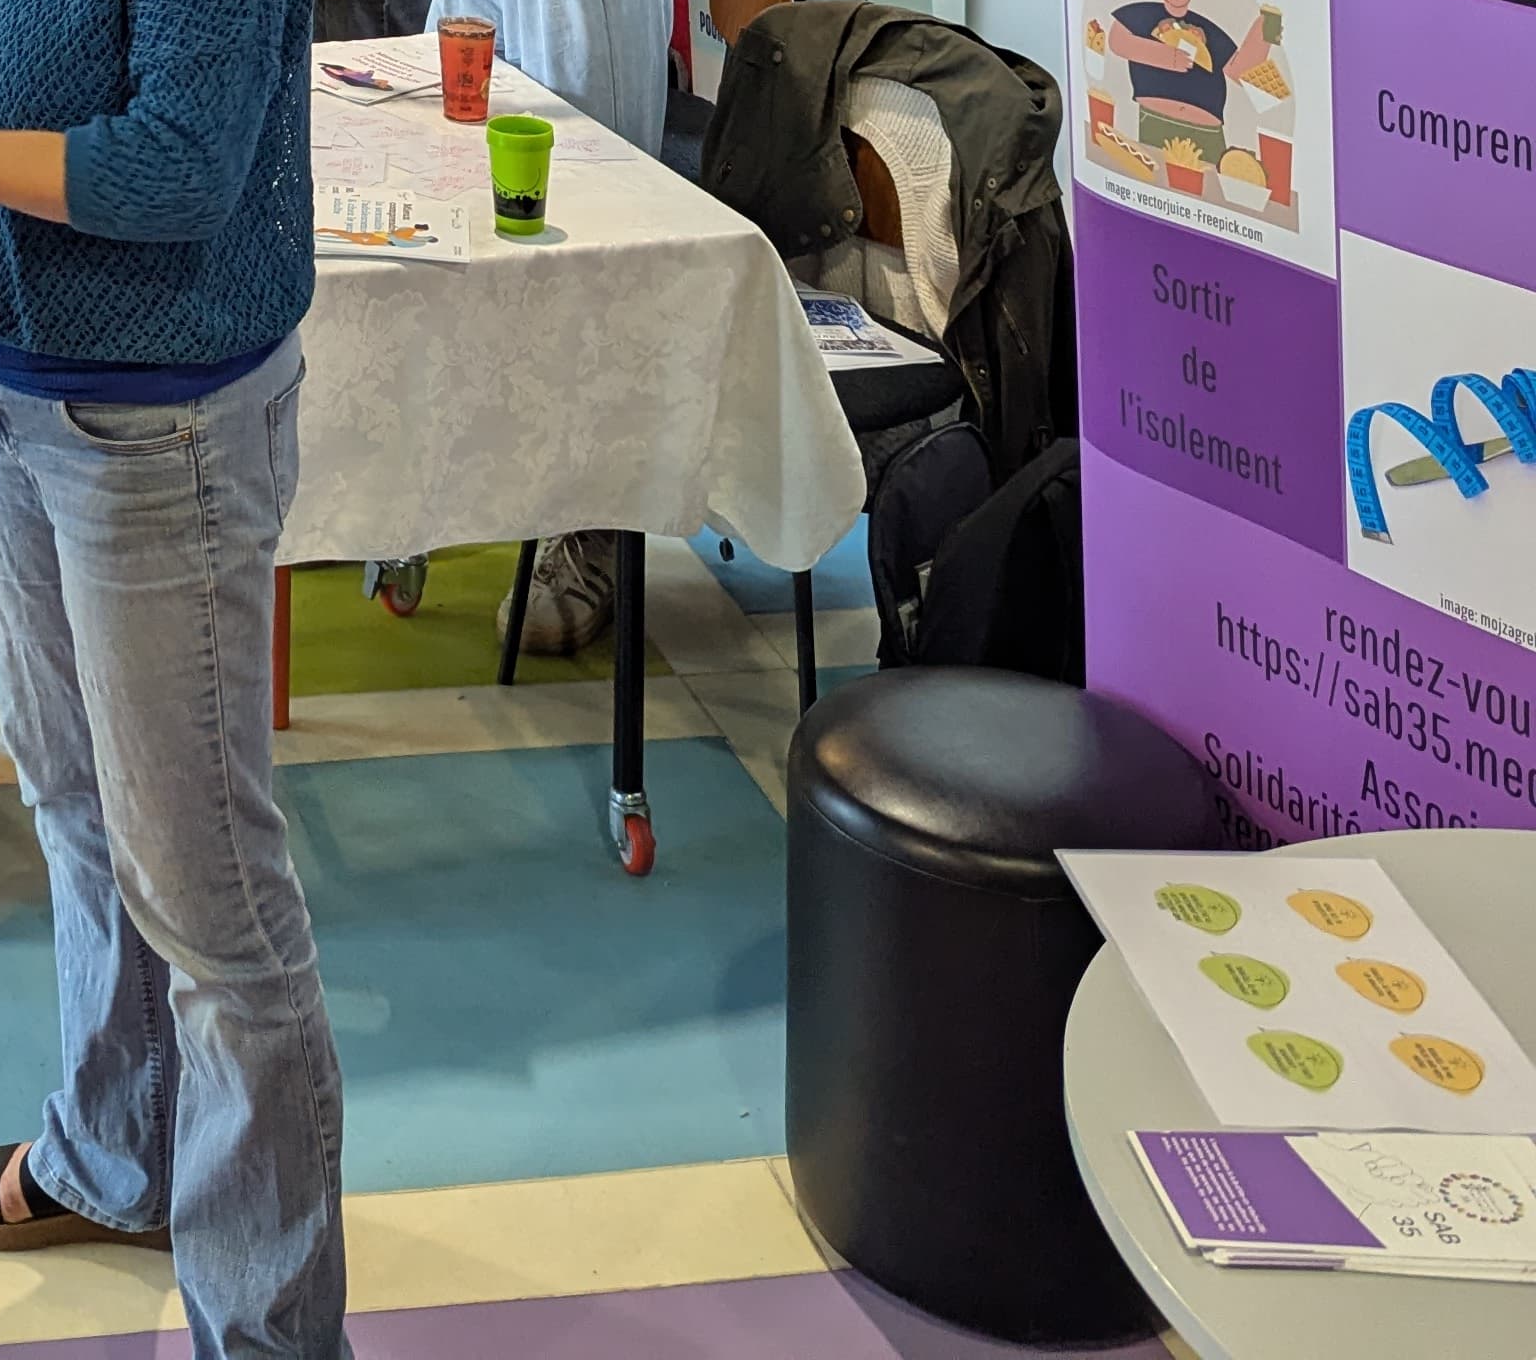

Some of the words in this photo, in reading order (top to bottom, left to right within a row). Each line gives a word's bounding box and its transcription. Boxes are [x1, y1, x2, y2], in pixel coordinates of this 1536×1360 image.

[1377, 88, 1533, 171] Compren
[1104, 177, 1131, 201] image
[1136, 191, 1191, 218] vectorjuice
[1152, 261, 1236, 328] Sortir
[1181, 346, 1217, 394] de
[1119, 386, 1284, 496] l'isolement
[1440, 592, 1478, 623] image:
[1324, 604, 1531, 739] rendez-vou
[1392, 1215, 1423, 1238] 35
[1424, 1210, 1461, 1246] SAB
